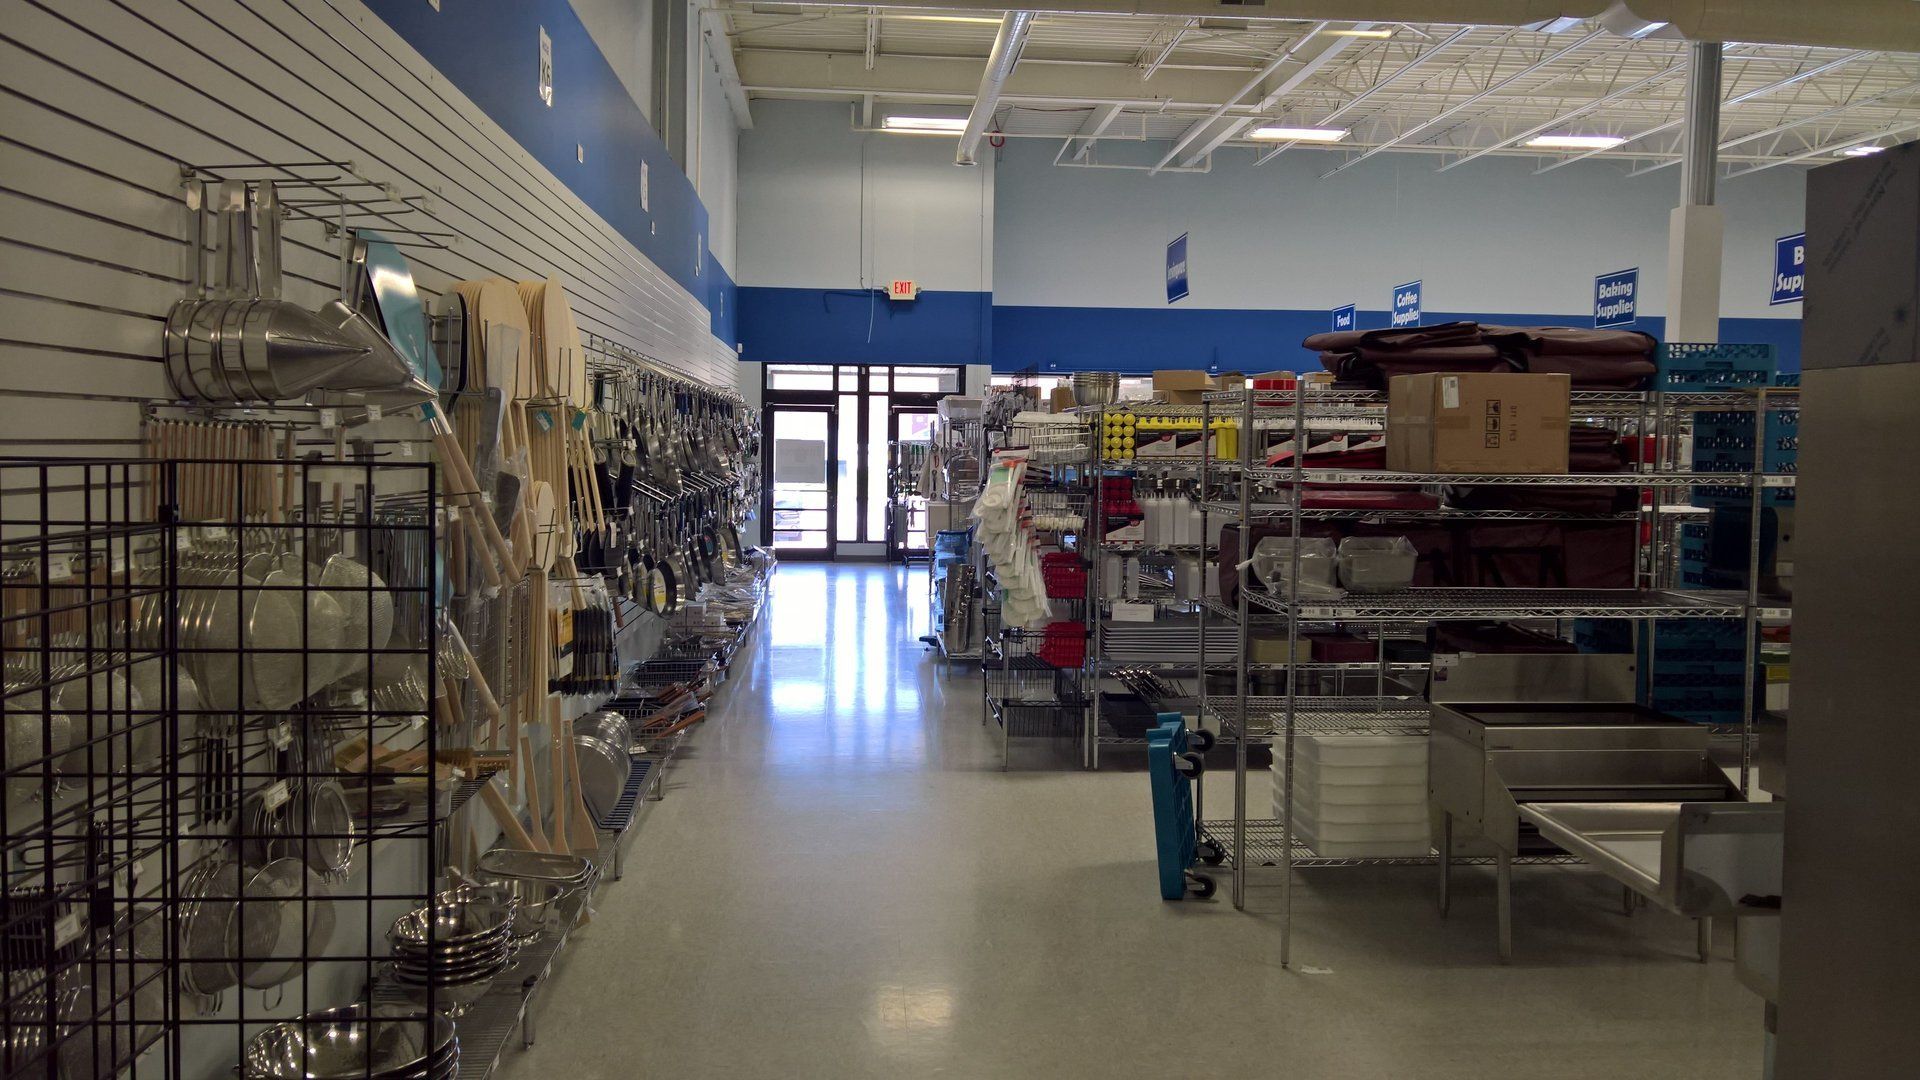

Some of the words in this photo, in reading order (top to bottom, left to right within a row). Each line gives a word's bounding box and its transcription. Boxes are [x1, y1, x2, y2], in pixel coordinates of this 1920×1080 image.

[894, 282, 912, 294] EXIT
[1598, 282, 1633, 300] Baking
[1397, 291, 1418, 308] Coffee
[1393, 307, 1419, 326] Supplies
[1596, 299, 1634, 320] Supplies
[1336, 312, 1351, 328] Food
